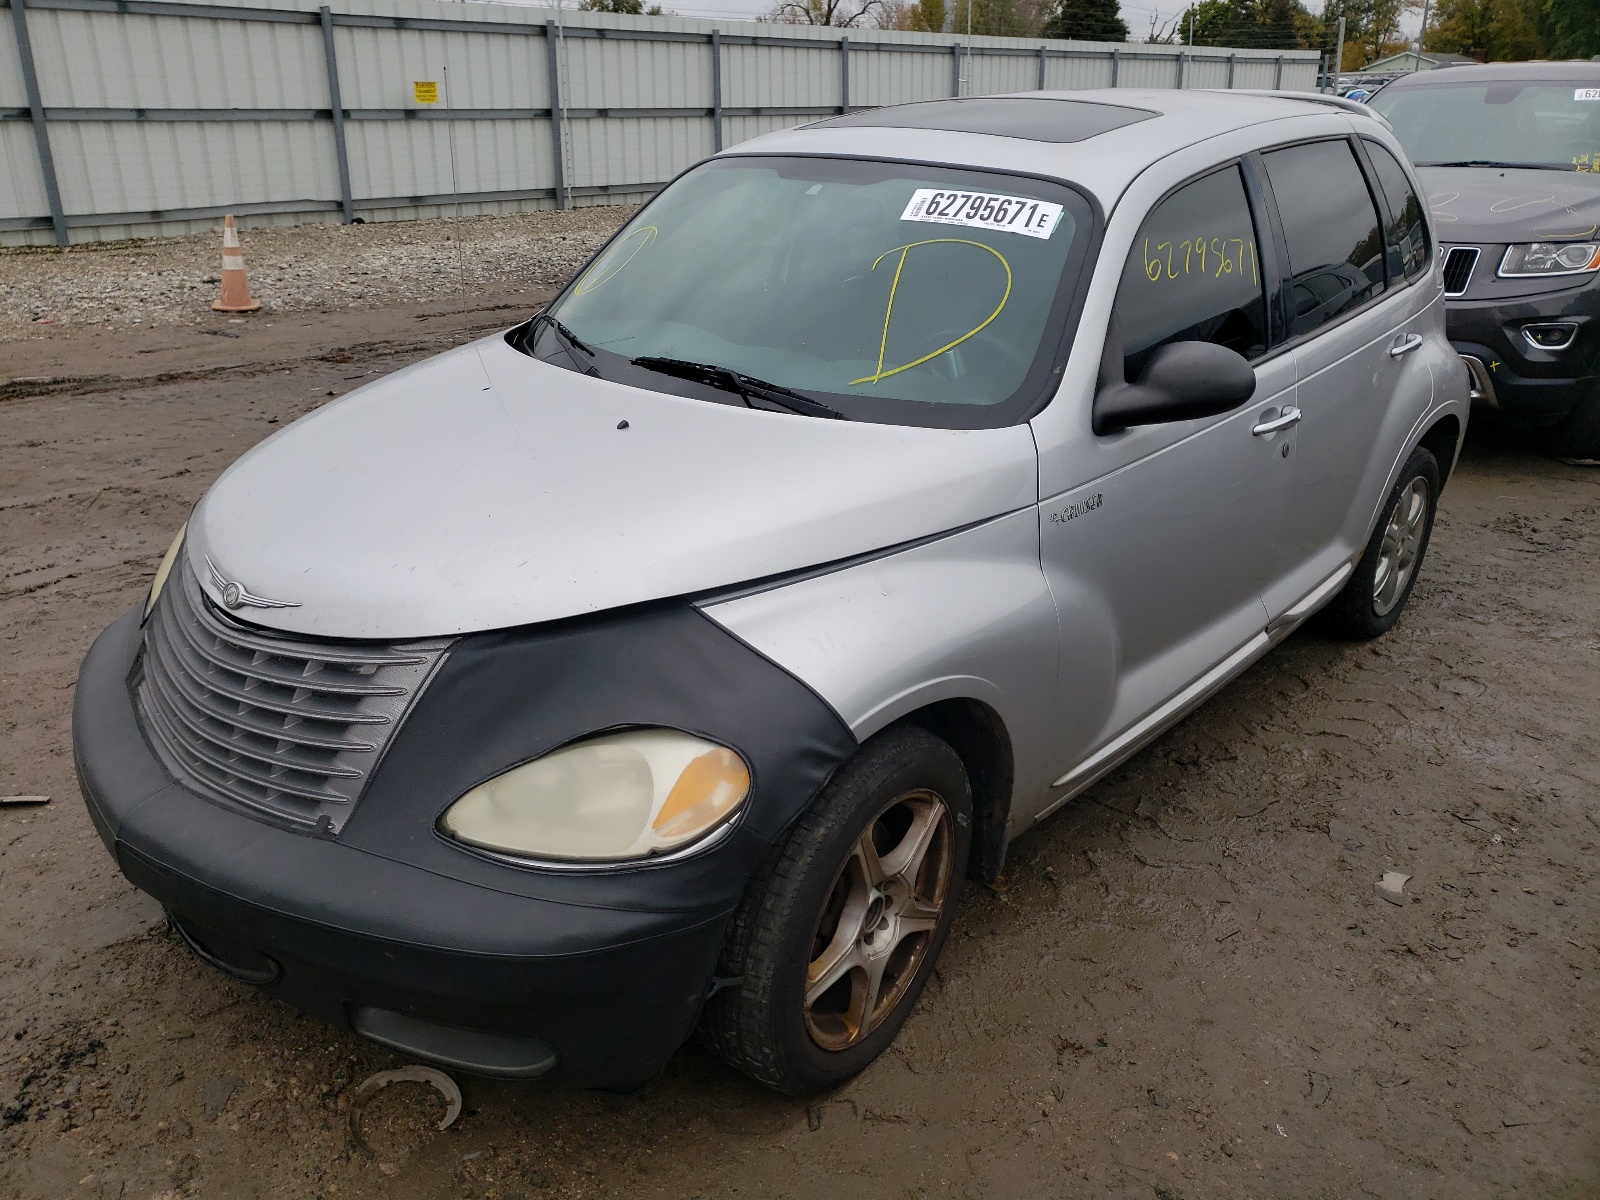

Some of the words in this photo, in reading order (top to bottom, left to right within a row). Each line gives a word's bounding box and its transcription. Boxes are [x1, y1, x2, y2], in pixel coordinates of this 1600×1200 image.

[1584, 89, 1600, 99] 62
[925, 192, 1039, 228] 62795671
[1037, 213, 1050, 228] E
[1143, 236, 1257, 287] 62795671
[848, 238, 1012, 385] D
[1060, 492, 1104, 523] CRUISER
